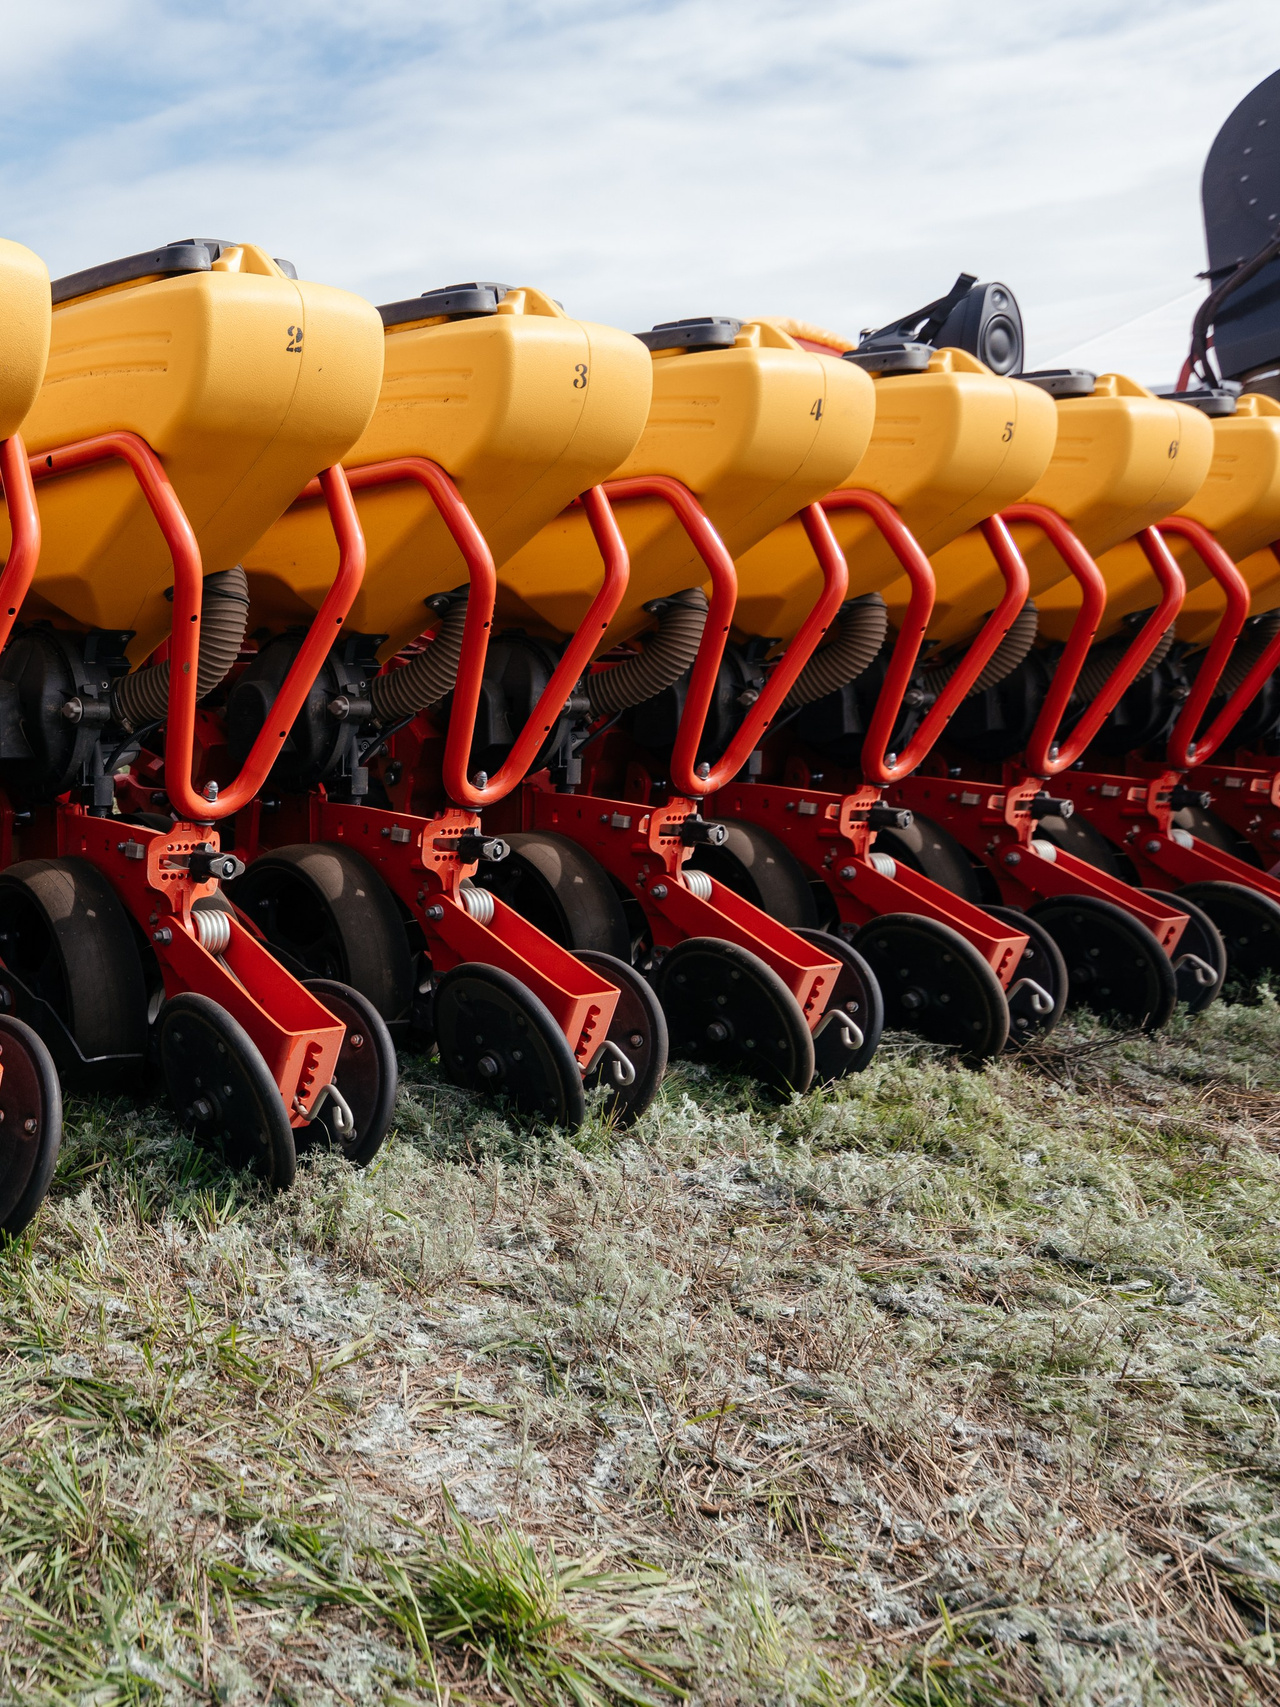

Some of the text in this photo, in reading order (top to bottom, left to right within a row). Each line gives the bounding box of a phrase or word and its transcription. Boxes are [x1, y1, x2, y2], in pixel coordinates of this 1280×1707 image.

[286, 325, 303, 353] 2
[573, 363, 588, 389] 3
[810, 398, 822, 421] 4
[1001, 421, 1014, 443] 5
[1168, 439, 1179, 460] 6
